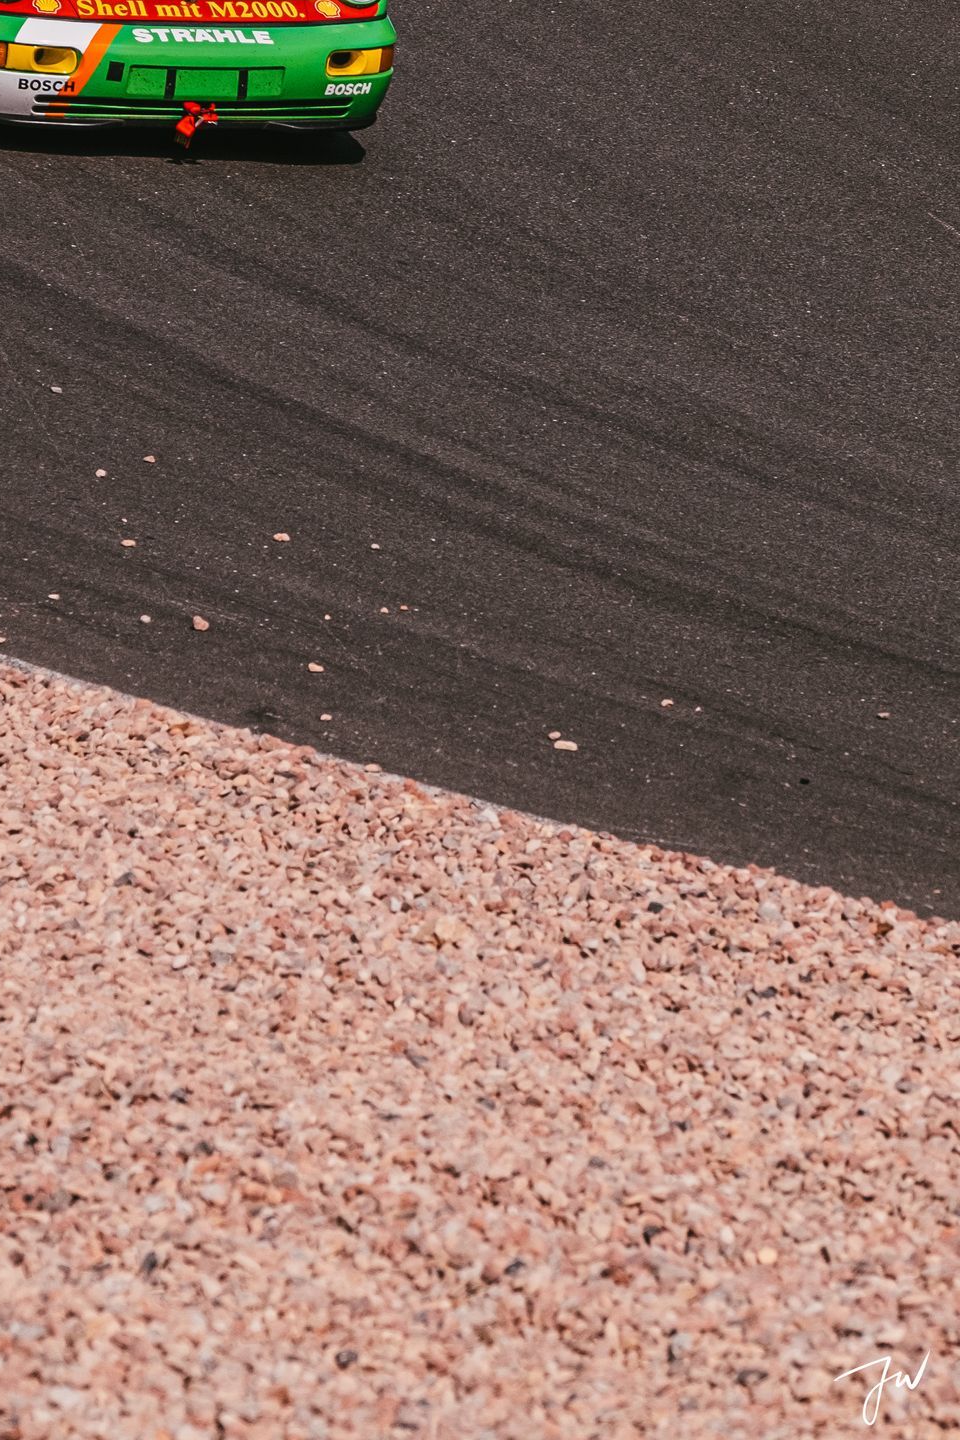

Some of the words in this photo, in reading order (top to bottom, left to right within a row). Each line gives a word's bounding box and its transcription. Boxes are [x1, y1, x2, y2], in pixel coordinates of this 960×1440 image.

[155, 0, 203, 18] mit
[205, 0, 307, 19] M2000.
[131, 27, 275, 46] STRÄHLE
[17, 78, 76, 93] BOSCH
[324, 82, 373, 97] BOSCH
